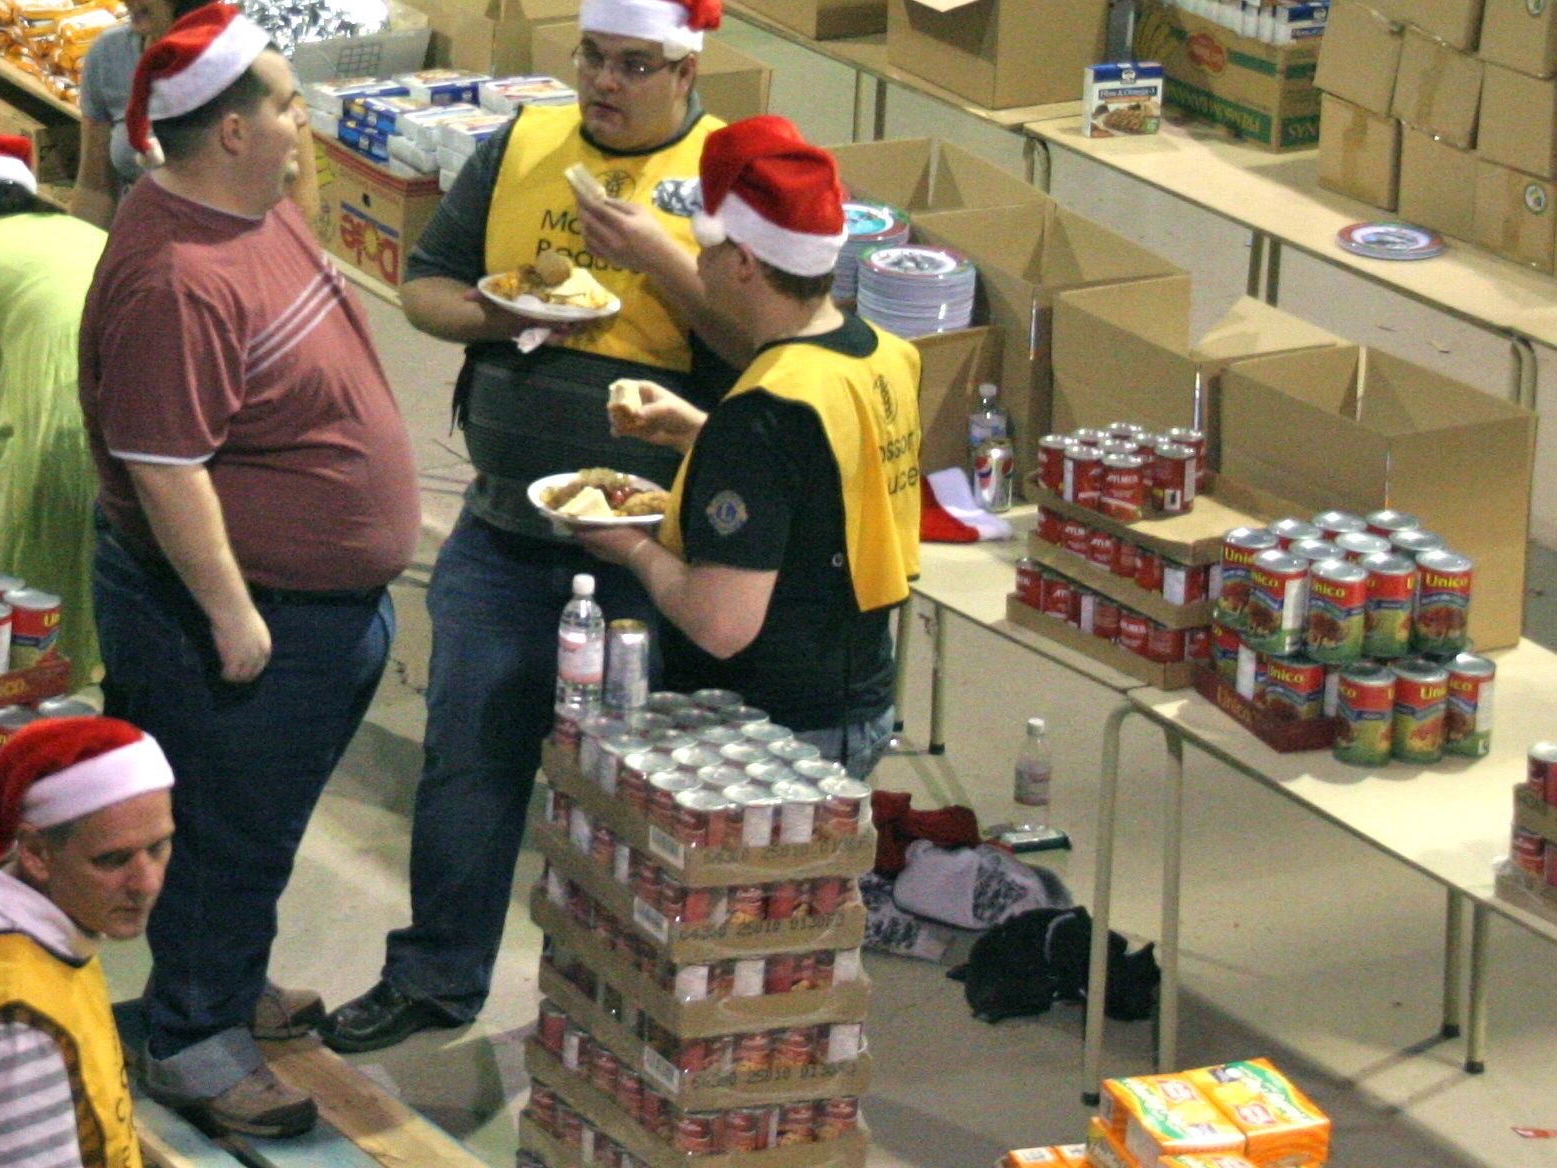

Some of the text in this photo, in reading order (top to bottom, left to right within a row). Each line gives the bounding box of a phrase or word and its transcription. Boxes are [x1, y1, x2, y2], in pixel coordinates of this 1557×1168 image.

[339, 213, 400, 288] Dole
[1251, 571, 1279, 588] nico
[1425, 572, 1468, 589] Unico
[1313, 581, 1346, 598] nico
[1267, 663, 1305, 684] Unico
